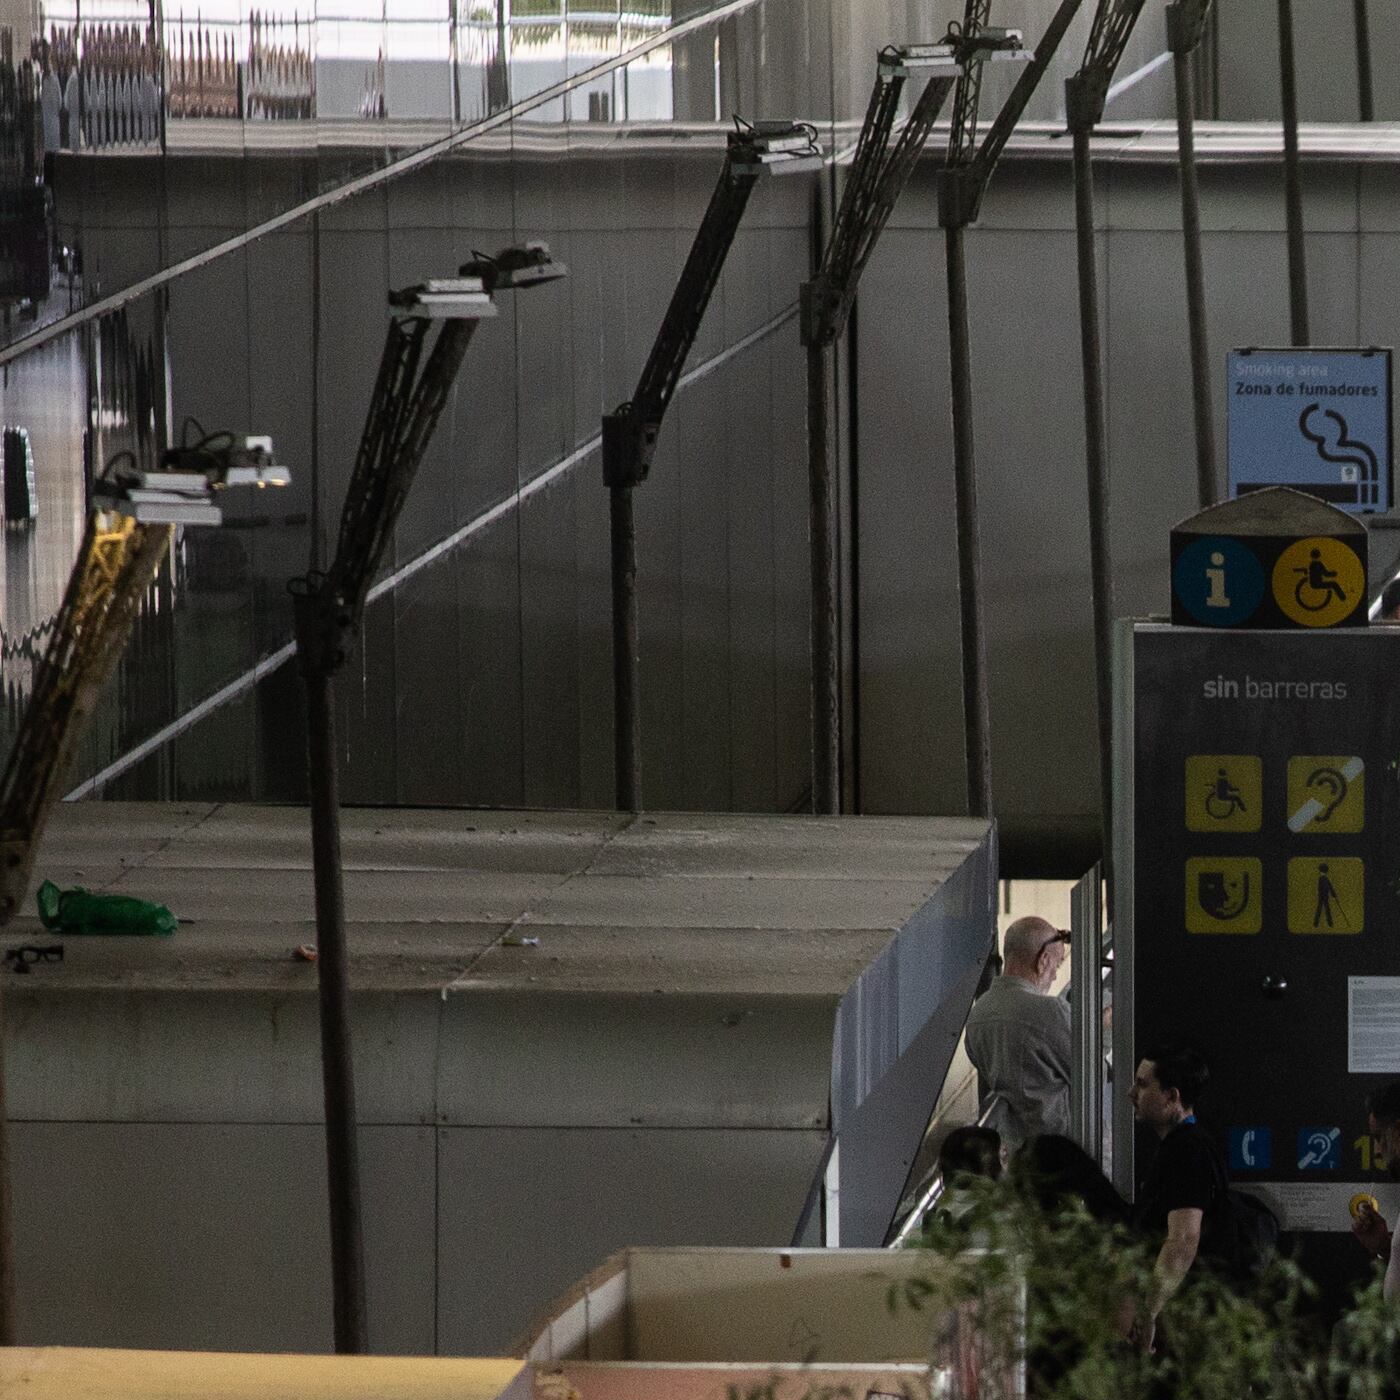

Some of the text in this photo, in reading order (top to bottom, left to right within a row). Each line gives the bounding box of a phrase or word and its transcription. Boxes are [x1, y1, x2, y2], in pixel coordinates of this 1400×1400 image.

[1236, 363, 1328, 377] Smoking area
[1236, 381, 1378, 395] Zona de fumadores
[1202, 673, 1347, 699] sin barreras
